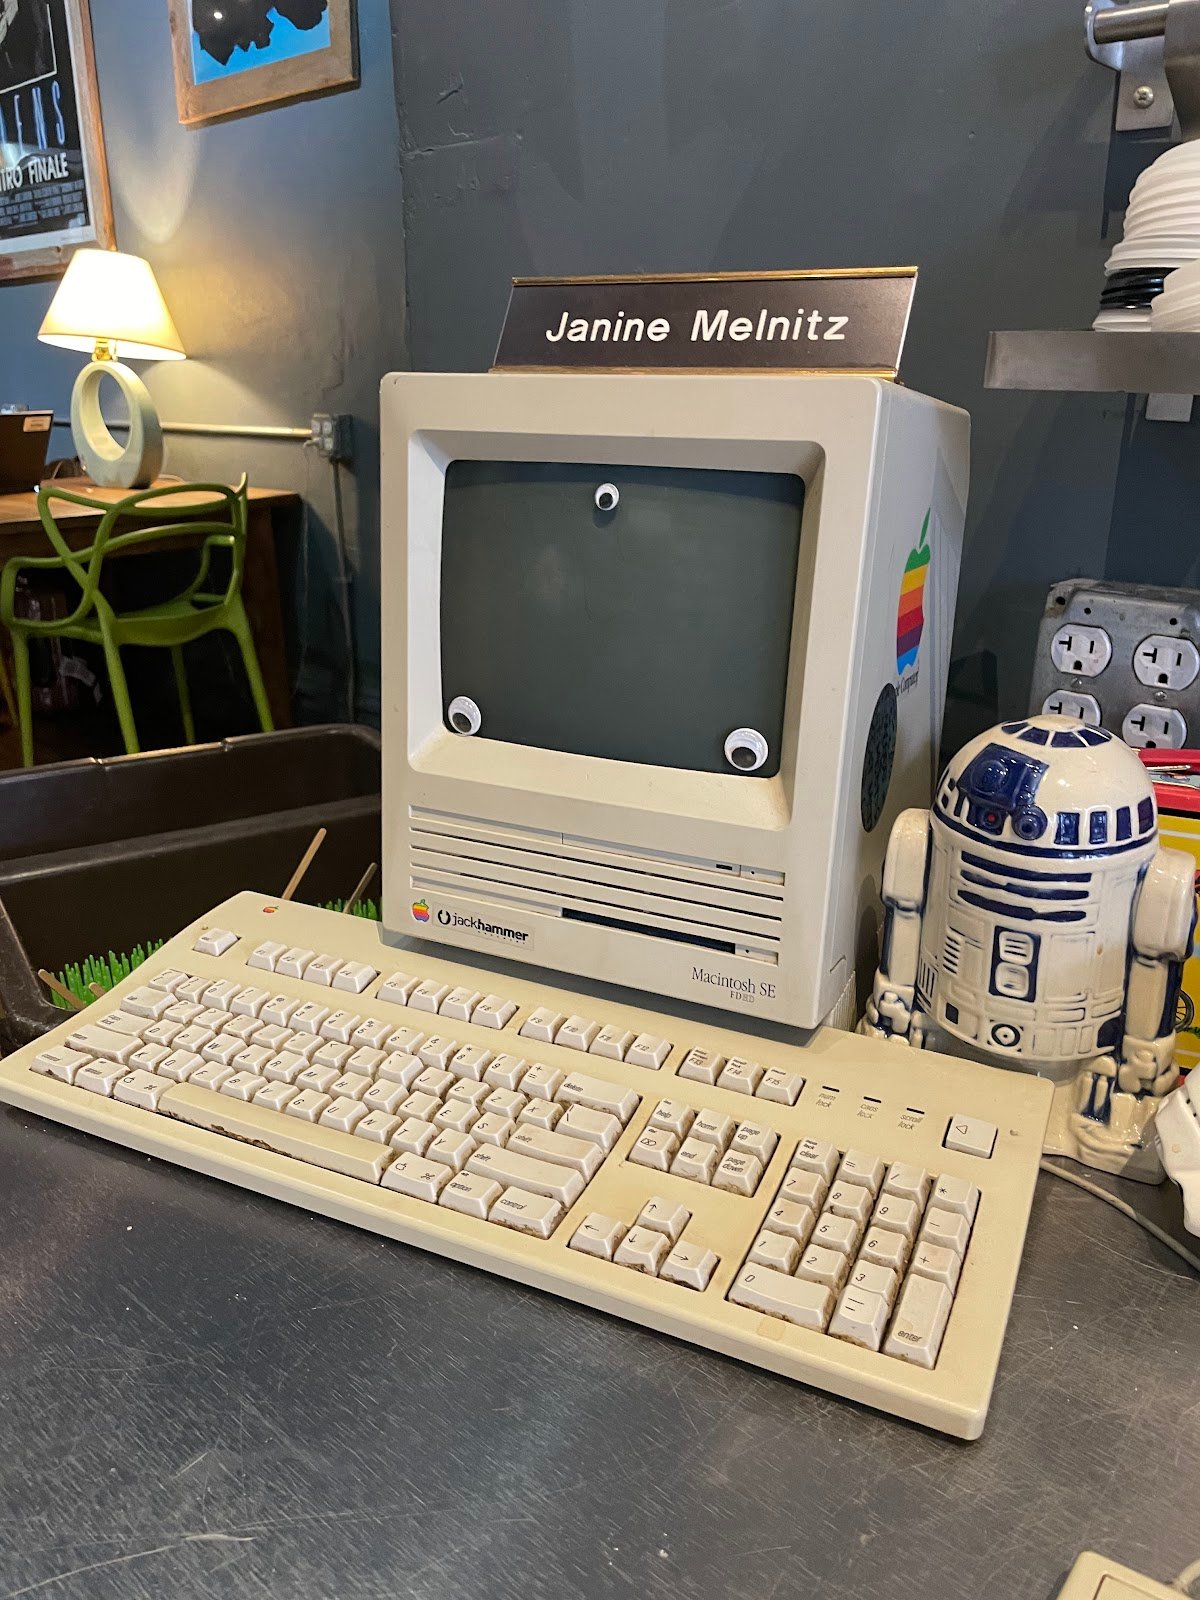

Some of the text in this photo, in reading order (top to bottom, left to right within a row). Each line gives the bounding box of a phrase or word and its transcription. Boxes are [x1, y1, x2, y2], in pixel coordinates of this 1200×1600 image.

[0, 152, 69, 192] TRO FINALE
[546, 308, 850, 342] Janine Melnitz
[452, 912, 528, 941] jackhammer
[692, 966, 776, 998] Macintosh SE
[818, 1093, 836, 1101] num
[816, 1099, 832, 1108] lock
[860, 1104, 878, 1112] caps
[656, 1110, 672, 1119] help
[857, 1110, 873, 1119] lock
[901, 1115, 923, 1123] scroll
[696, 1121, 717, 1131] home
[898, 1121, 915, 1130] lock
[741, 1126, 760, 1136] page
[474, 1153, 491, 1161] shift
[681, 1151, 697, 1159] end
[800, 1150, 819, 1159] clear
[727, 1157, 746, 1166] page
[722, 1163, 743, 1173] down
[450, 1182, 472, 1192] option
[500, 1198, 527, 1210] control
[879, 1206, 889, 1215] 9
[819, 1225, 829, 1233] 5
[868, 1240, 878, 1248] 6
[806, 1257, 817, 1265] 2
[744, 1274, 755, 1283] 0
[855, 1273, 866, 1282] 3
[897, 1330, 922, 1344] enter
